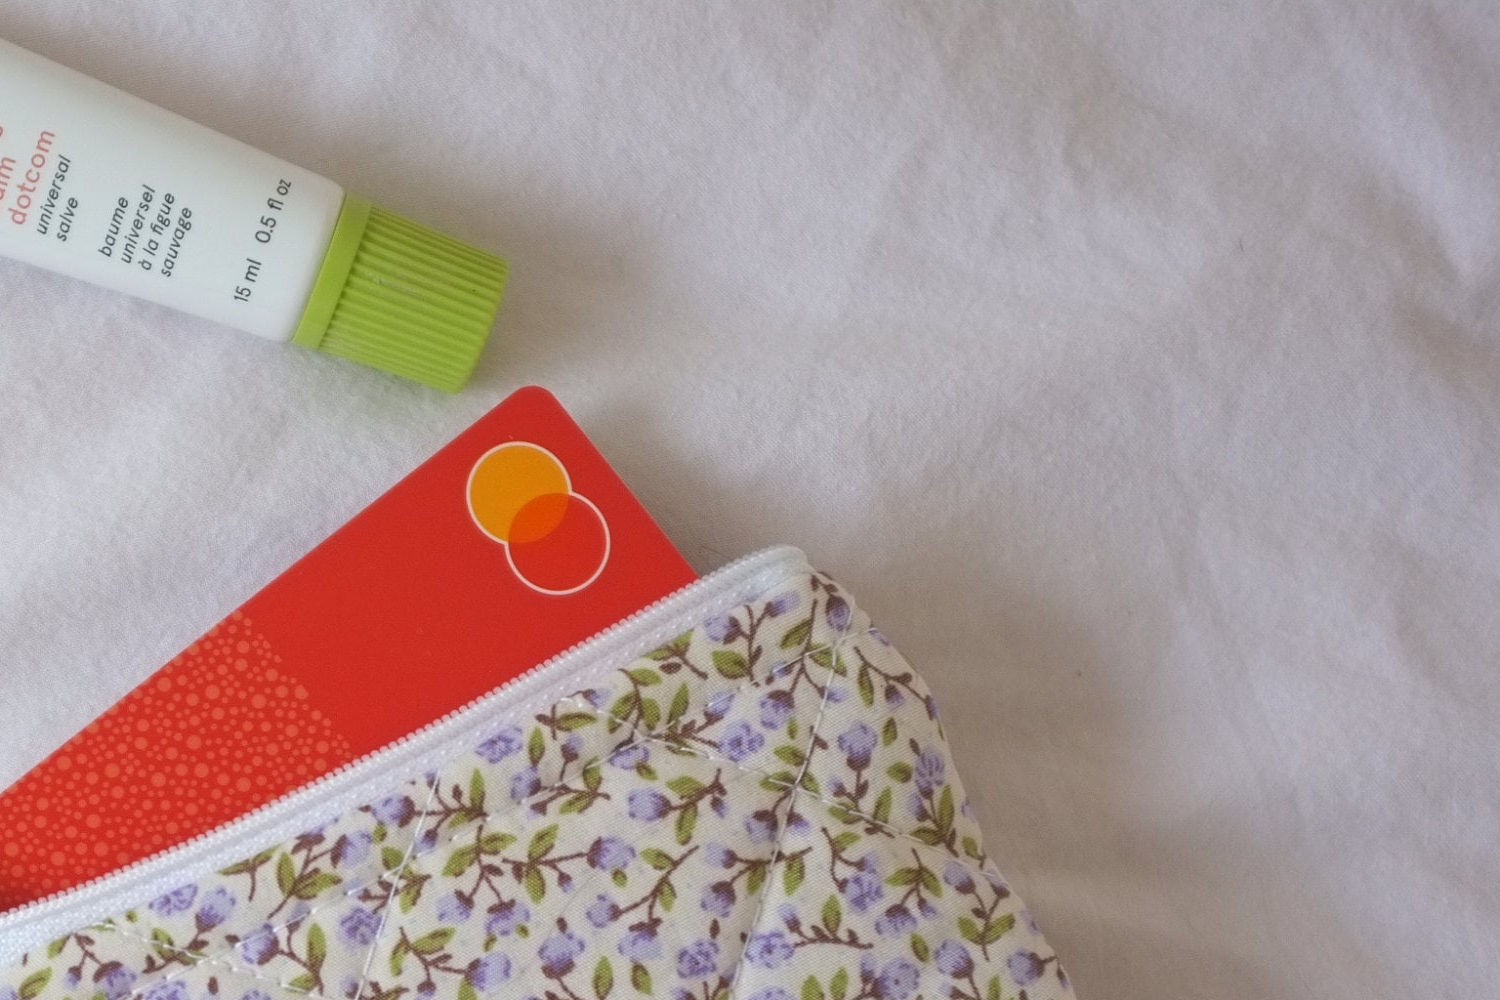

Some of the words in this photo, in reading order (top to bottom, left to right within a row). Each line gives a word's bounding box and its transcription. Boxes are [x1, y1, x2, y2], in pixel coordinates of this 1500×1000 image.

[8, 131, 55, 225] dotcom
[37, 154, 71, 235] universal
[56, 197, 78, 242] salve
[98, 196, 129, 257] baume
[120, 183, 156, 264] universel
[150, 192, 175, 236] figue
[161, 207, 193, 277] sauvage
[233, 285, 252, 302] 15
[244, 257, 262, 283] ml
[254, 215, 277, 244] 0.5
[267, 198, 284, 211] fl
[276, 178, 292, 196] oz
[137, 260, 152, 271] à
[143, 238, 159, 256] la
